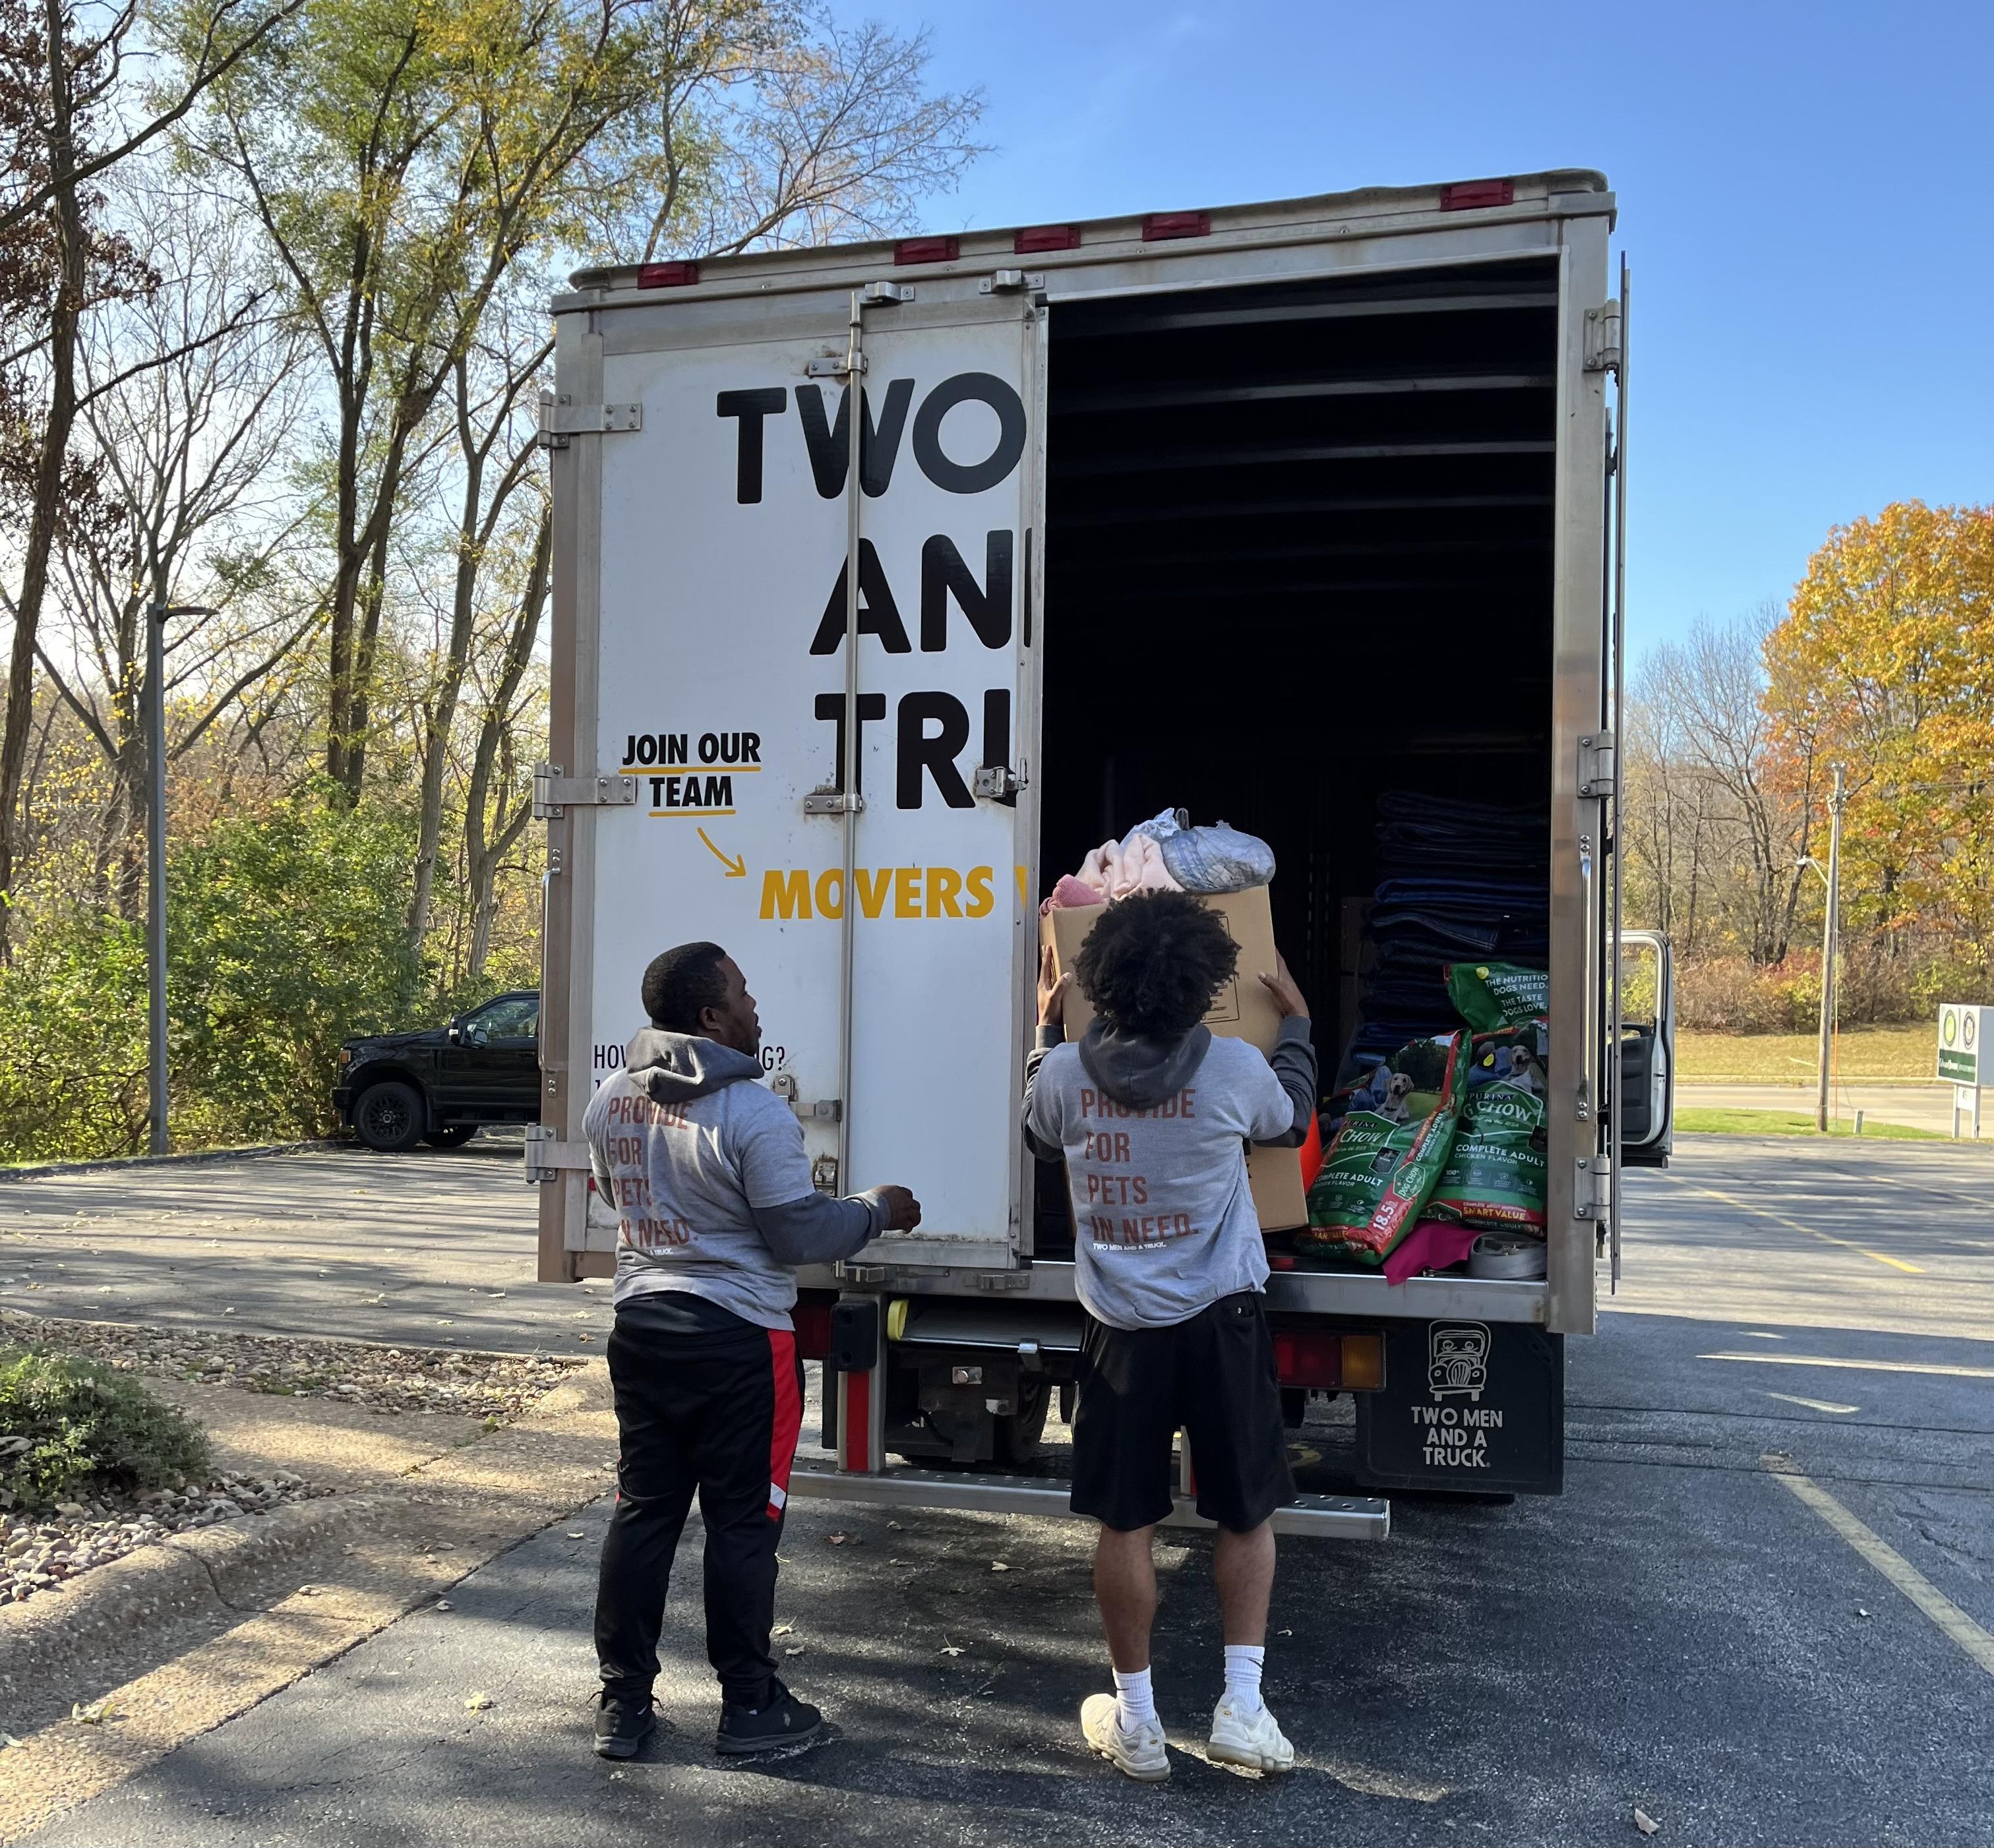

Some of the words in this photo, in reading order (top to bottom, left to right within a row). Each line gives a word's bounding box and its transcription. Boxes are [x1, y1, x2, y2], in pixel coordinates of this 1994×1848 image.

[717, 372, 1027, 504] TWO
[809, 527, 1032, 655] AN
[622, 734, 688, 765] JOIN
[698, 732, 761, 763] OUR
[650, 776, 733, 807] TEAM
[759, 866, 994, 920] MOVERS
[1485, 978, 1501, 988] THE
[1494, 984, 1517, 996] DOGS
[1501, 998, 1516, 1007] THE
[1517, 994, 1543, 1003] TASTE
[1524, 1001, 1548, 1013] LOVE.
[1470, 1092, 1512, 1101] PURINA
[1476, 1101, 1532, 1121] CHOW
[1085, 1132, 1130, 1162] FOR
[1339, 1129, 1386, 1143] CHOW
[1416, 1133, 1434, 1161] COMPLETE
[609, 1137, 642, 1165] FOR
[1456, 1145, 1508, 1156] COMPLETE
[1509, 1150, 1545, 1168] ADULT
[1488, 1155, 1518, 1166] FLAVOR
[1087, 1174, 1148, 1205] PETS
[1350, 1174, 1384, 1186] ADULT
[1373, 1204, 1395, 1230] 18.5
[1463, 1207, 1494, 1216] SMART
[1495, 1209, 1526, 1220] VALUE
[1090, 1215, 1114, 1242] IN
[1122, 1213, 1199, 1243] NEED.
[1410, 1406, 1458, 1425] TWO
[1463, 1408, 1503, 1427] MEN
[1426, 1427, 1468, 1446] AND
[1474, 1429, 1488, 1447] A
